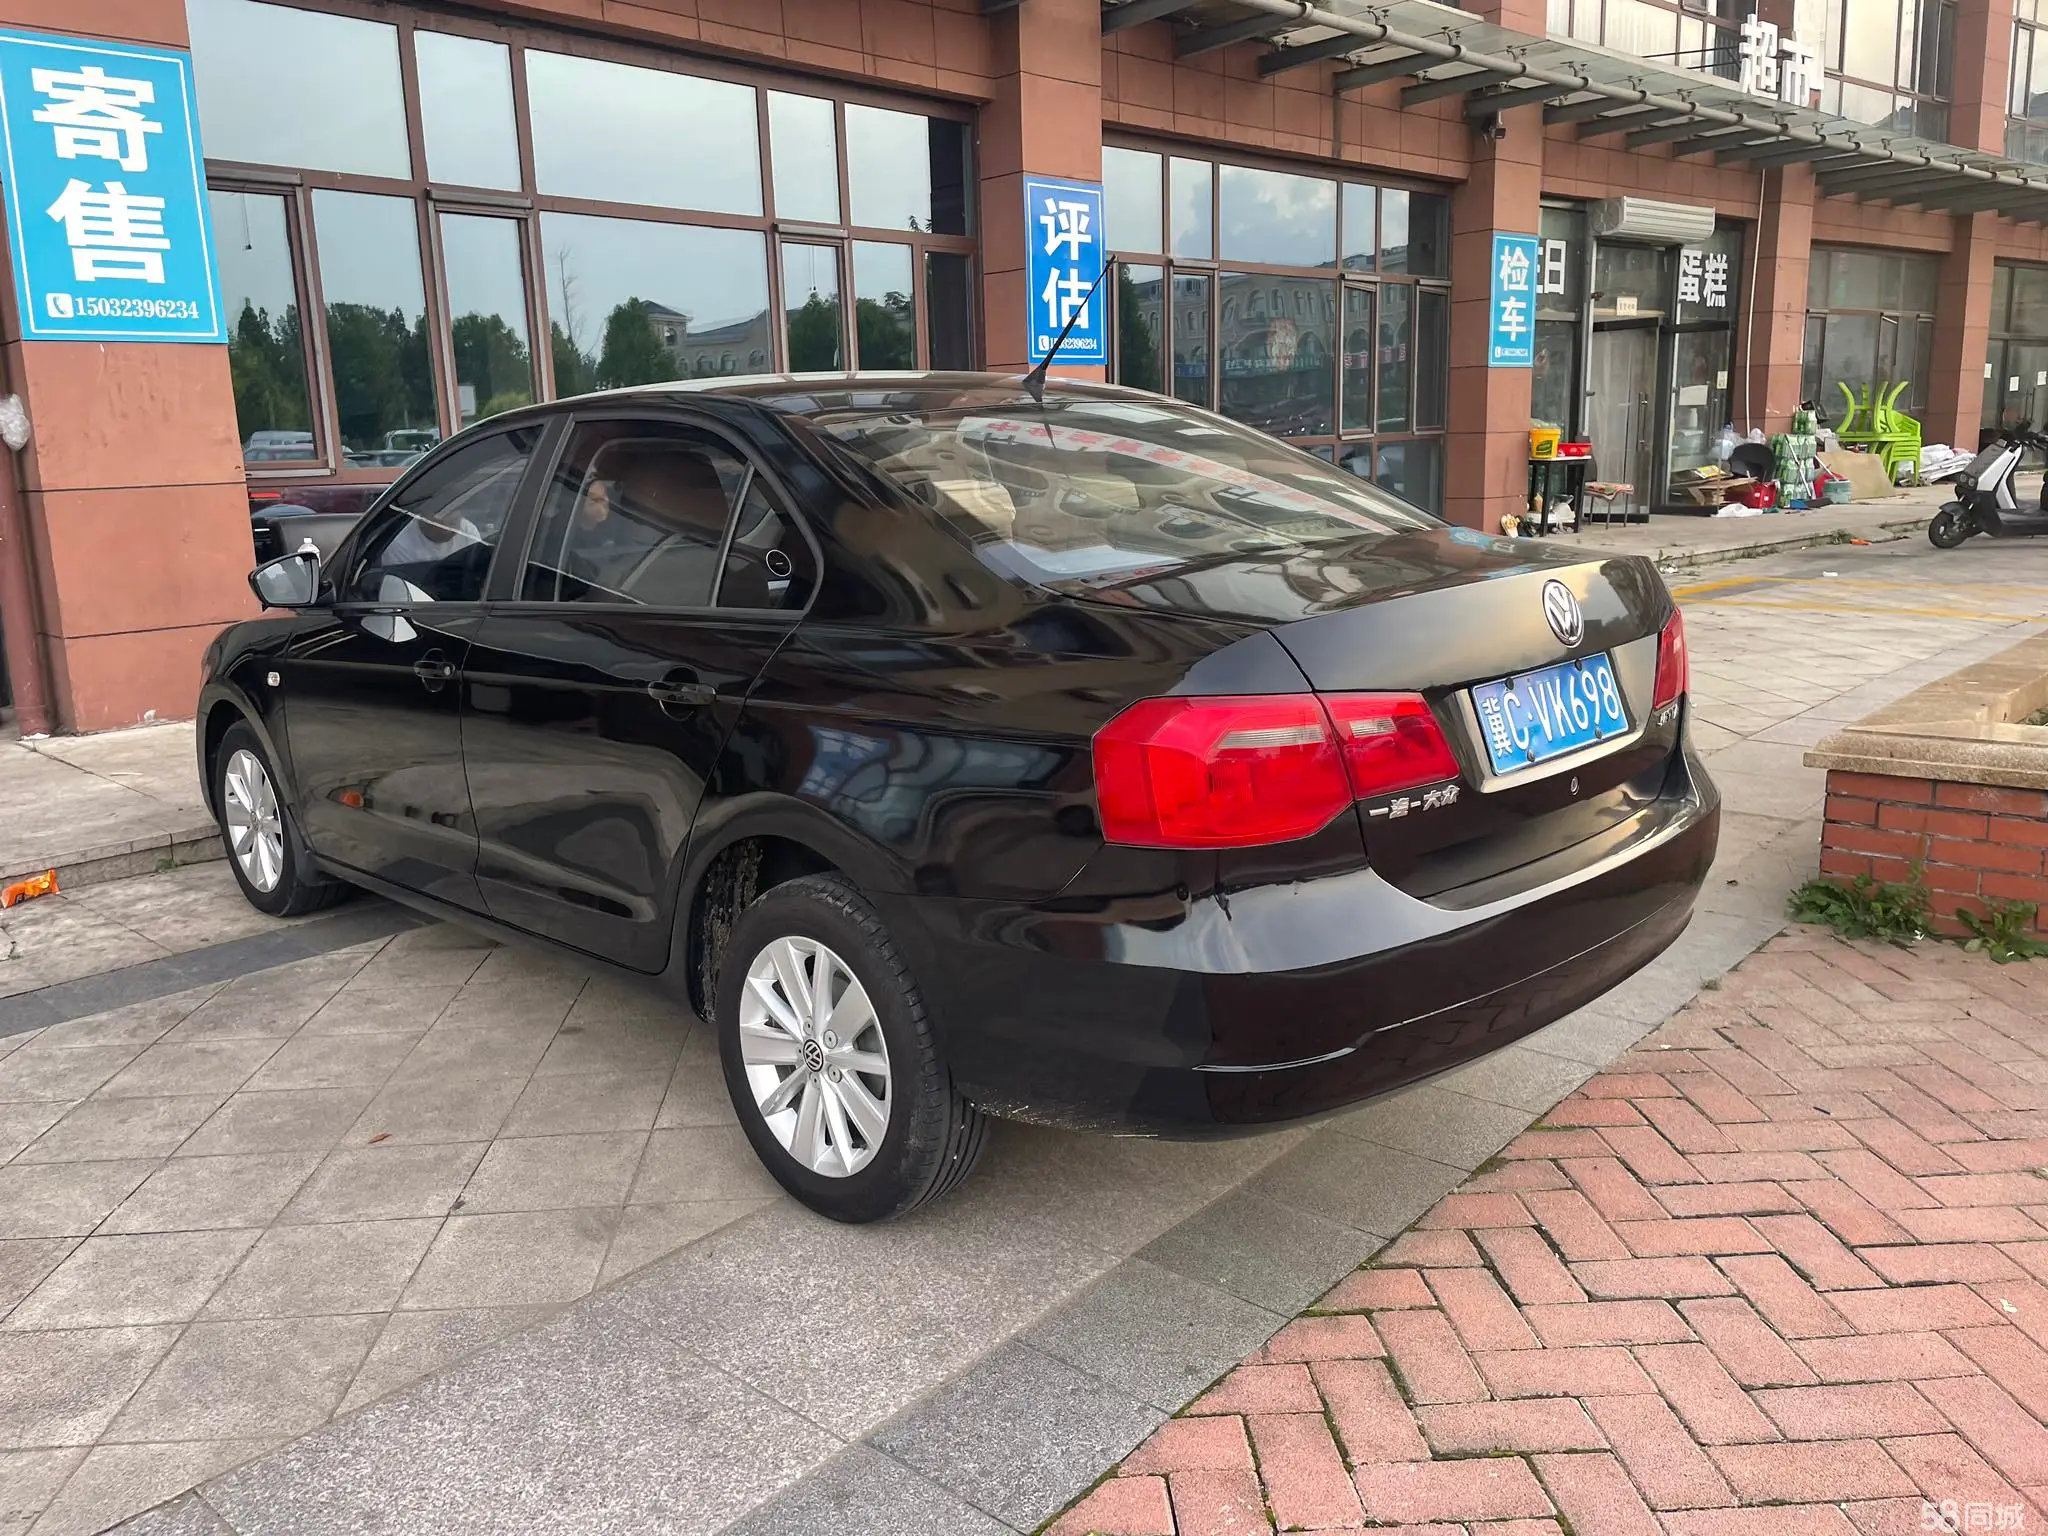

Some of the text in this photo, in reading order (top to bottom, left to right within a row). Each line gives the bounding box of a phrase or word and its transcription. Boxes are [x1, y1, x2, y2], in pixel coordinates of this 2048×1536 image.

[1738, 13, 1814, 108] 超市
[31, 65, 171, 284] 寄售
[74, 297, 200, 319] 15032396234
[1040, 198, 1093, 329] 评估
[1498, 245, 1530, 342] 检车
[1679, 248, 1728, 308] 蛋糕
